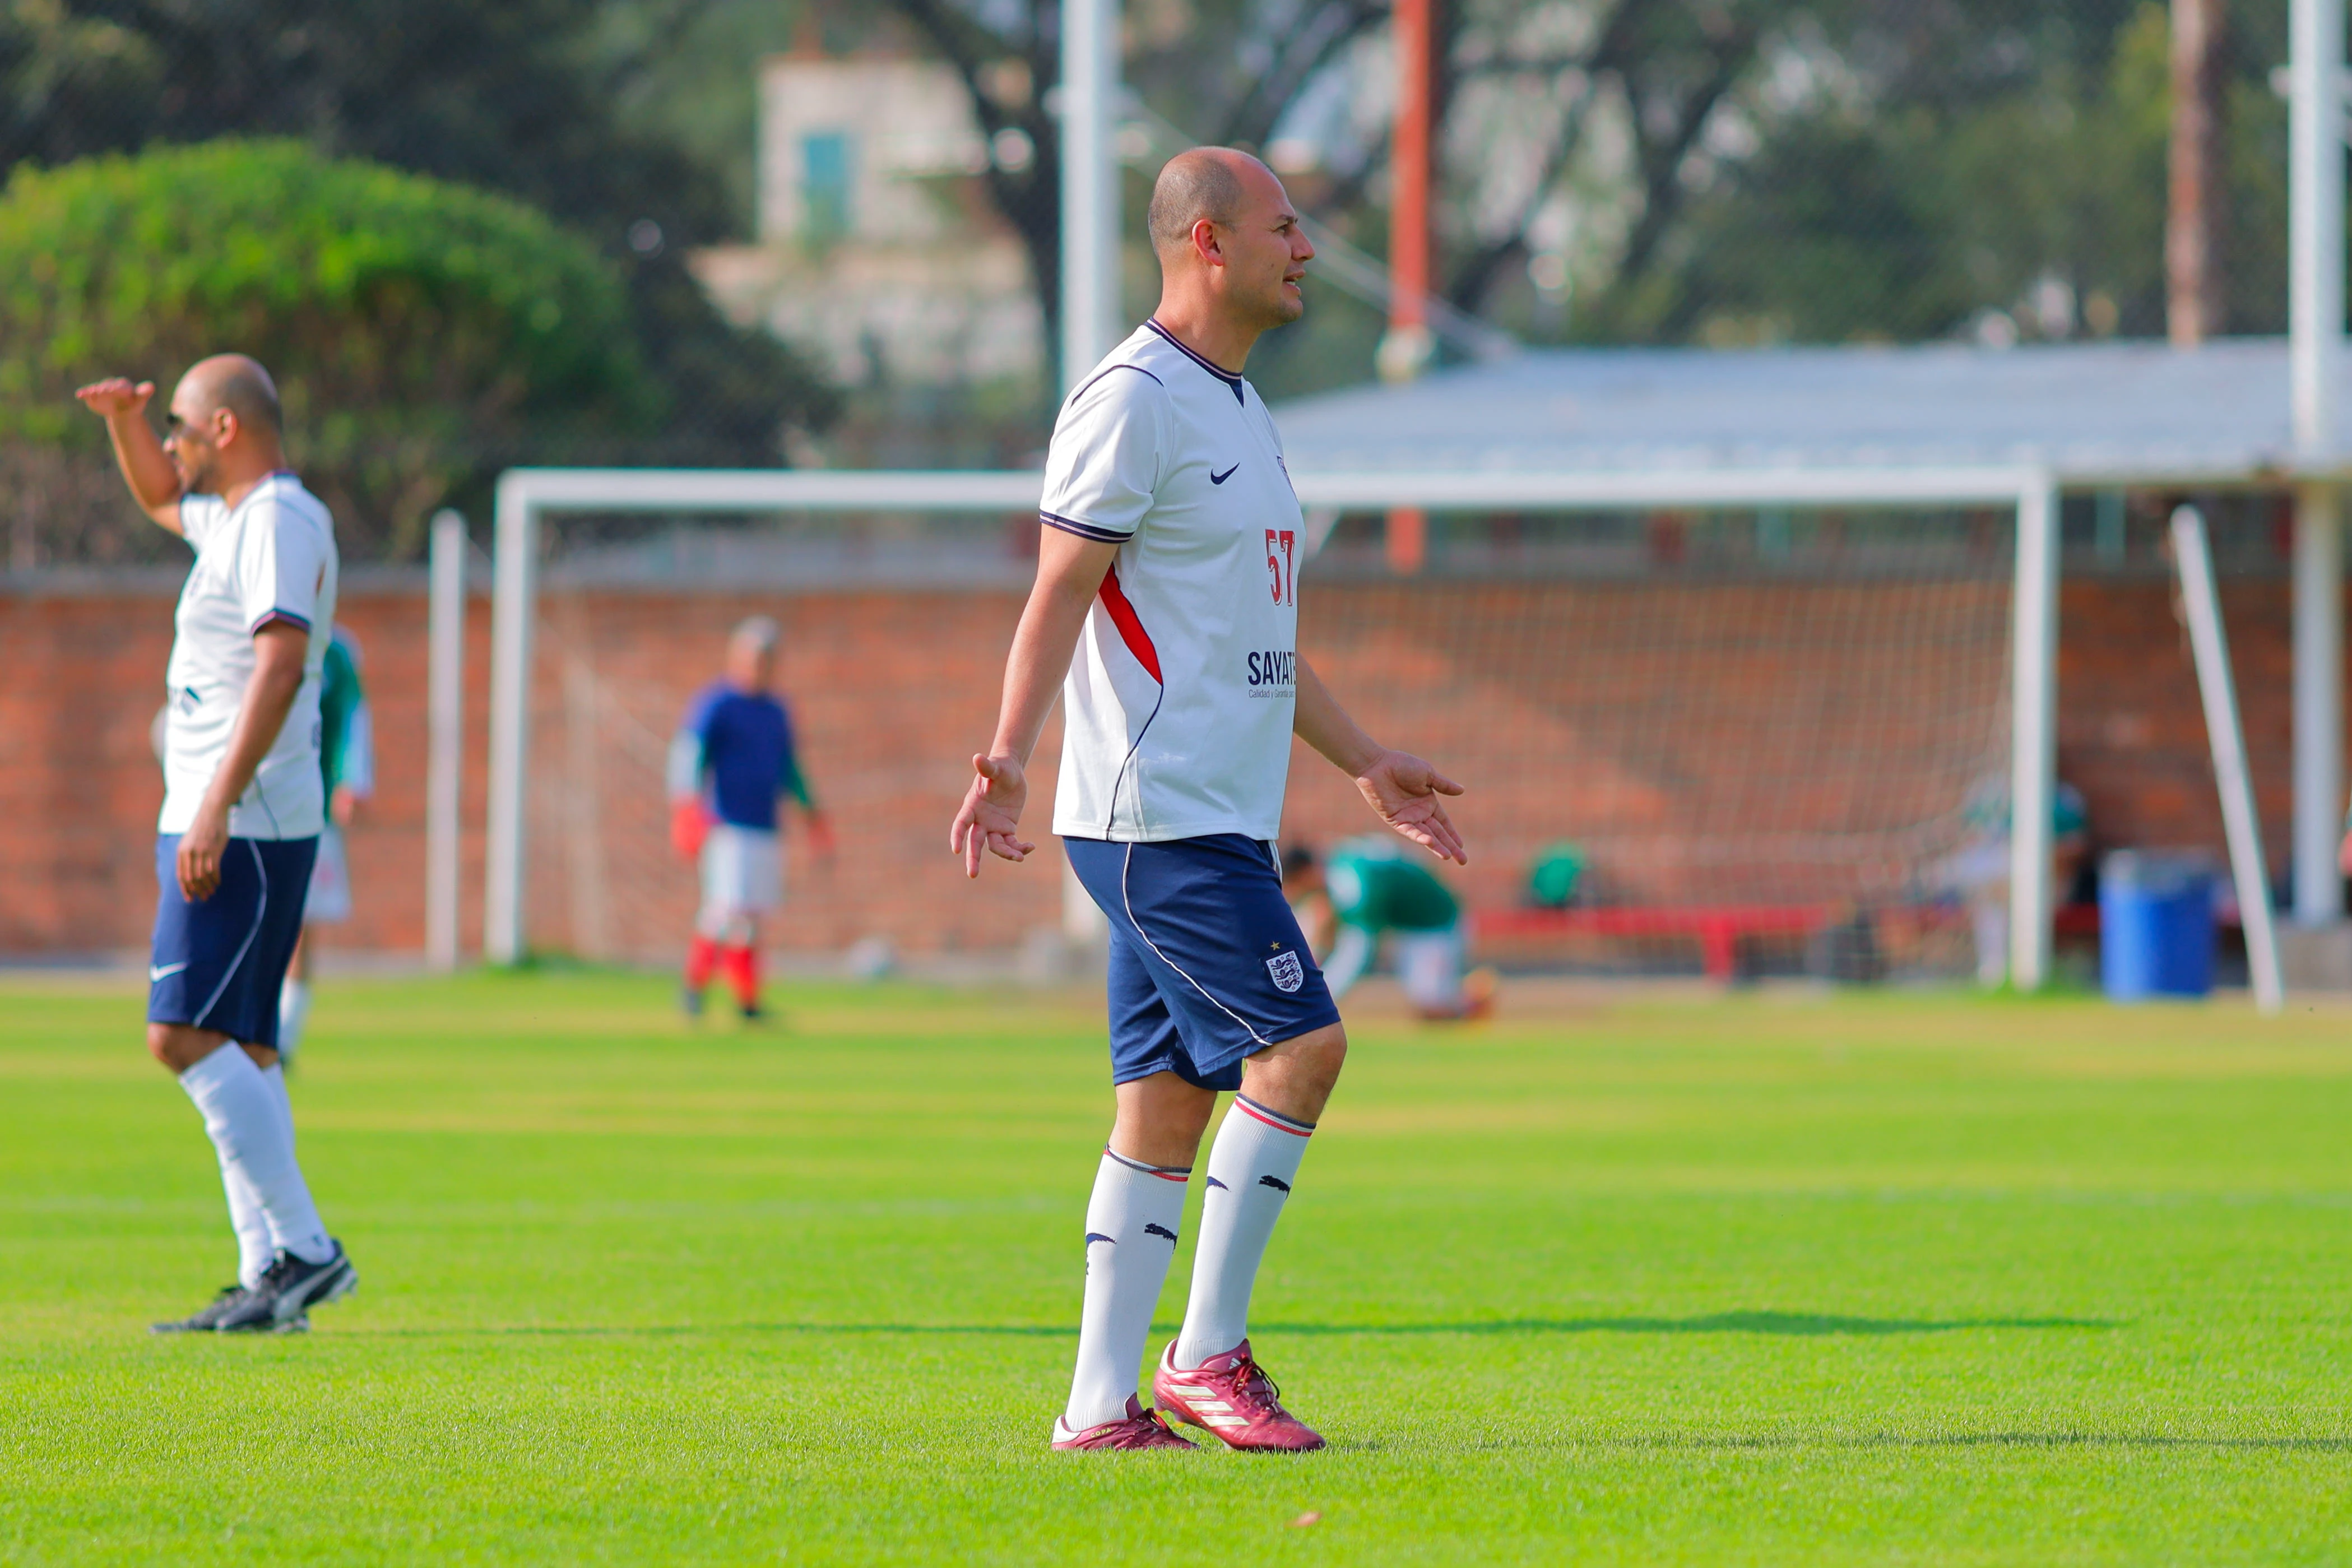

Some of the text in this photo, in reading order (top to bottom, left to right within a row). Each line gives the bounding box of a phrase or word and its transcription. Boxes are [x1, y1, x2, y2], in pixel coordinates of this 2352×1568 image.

[1265, 529, 1295, 606] 57
[1249, 689, 1270, 698] Calidad
[1270, 691, 1274, 700] y
[1090, 1427, 1112, 1438] COPA
